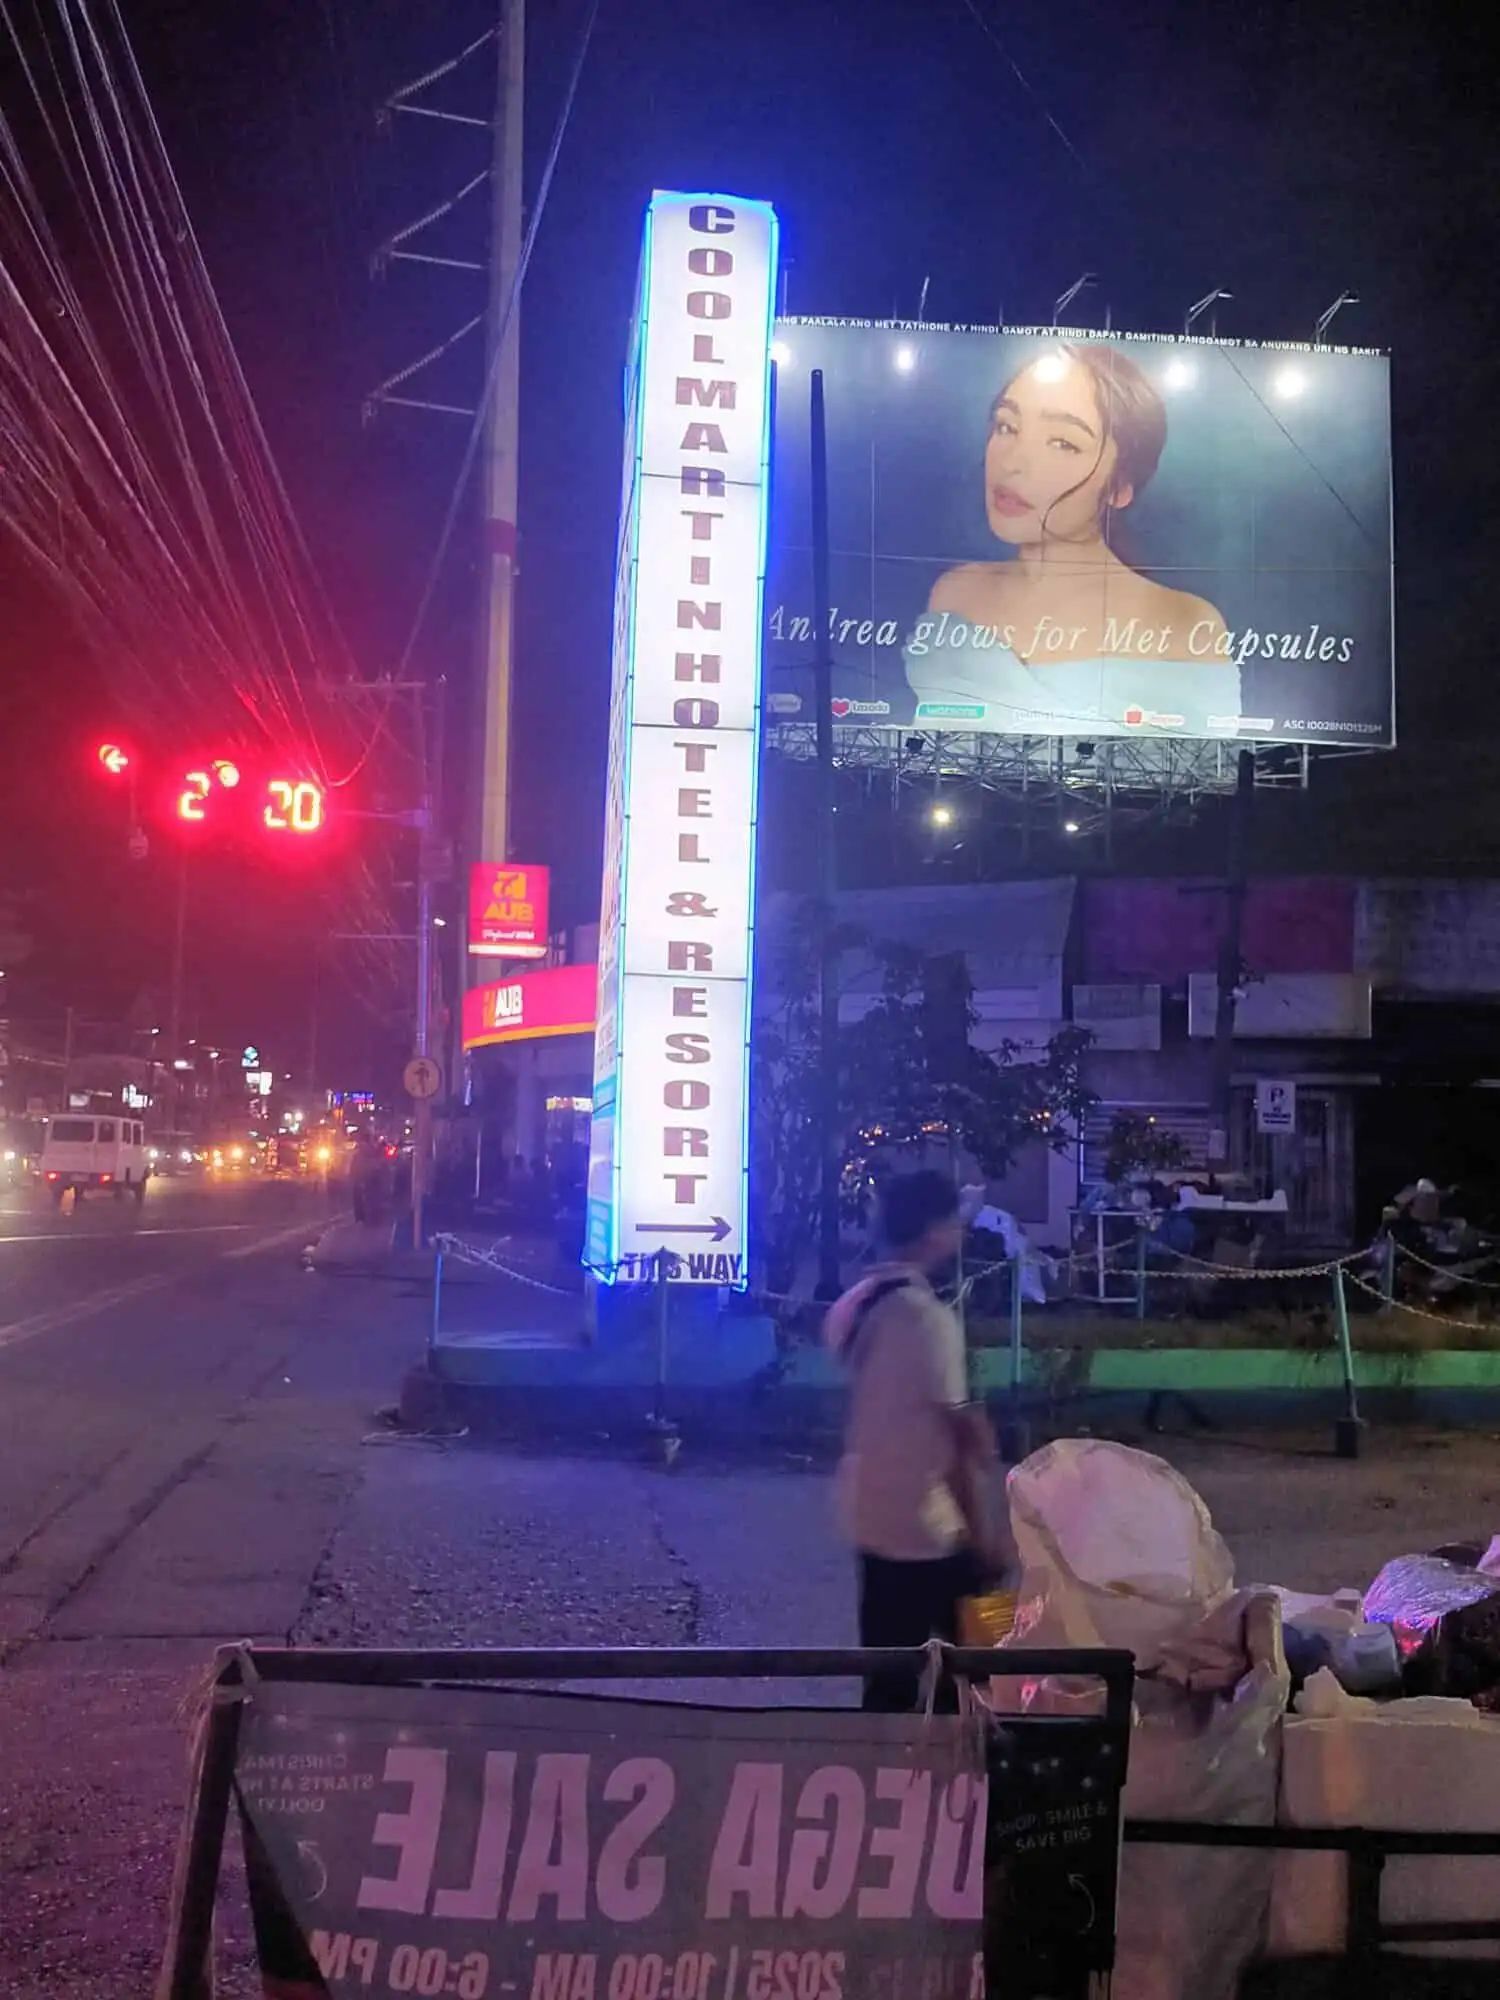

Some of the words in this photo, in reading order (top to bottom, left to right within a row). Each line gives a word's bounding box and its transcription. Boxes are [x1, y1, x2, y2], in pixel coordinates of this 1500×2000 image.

[875, 318, 895, 330] MET
[970, 323, 999, 334] HINDI
[1002, 325, 1037, 337] GAMOT
[1058, 327, 1086, 339] HINDI
[1089, 328, 1121, 341] DAPAT
[1125, 331, 1174, 344] GAMITING
[1245, 338, 1258, 349] SA
[1261, 339, 1310, 352] ANUMANG
[1313, 342, 1331, 354] URI
[1352, 346, 1380, 357] SAKIT
[908, 612, 1014, 655] glows
[1021, 616, 1088, 658] for
[1098, 618, 1173, 654] Met
[1188, 620, 1355, 666] Capsules
[1283, 719, 1305, 730] ASC
[673, 652, 721, 863] HOTEL
[482, 901, 535, 922] AUB
[665, 891, 718, 917] &
[495, 984, 523, 1017] AUB
[663, 940, 714, 1204] RESORT
[624, 1252, 682, 1279] THS
[688, 1252, 742, 1280] WAY
[1015, 1831, 1058, 1854] SAVE
[1062, 1825, 1093, 1845] BIG
